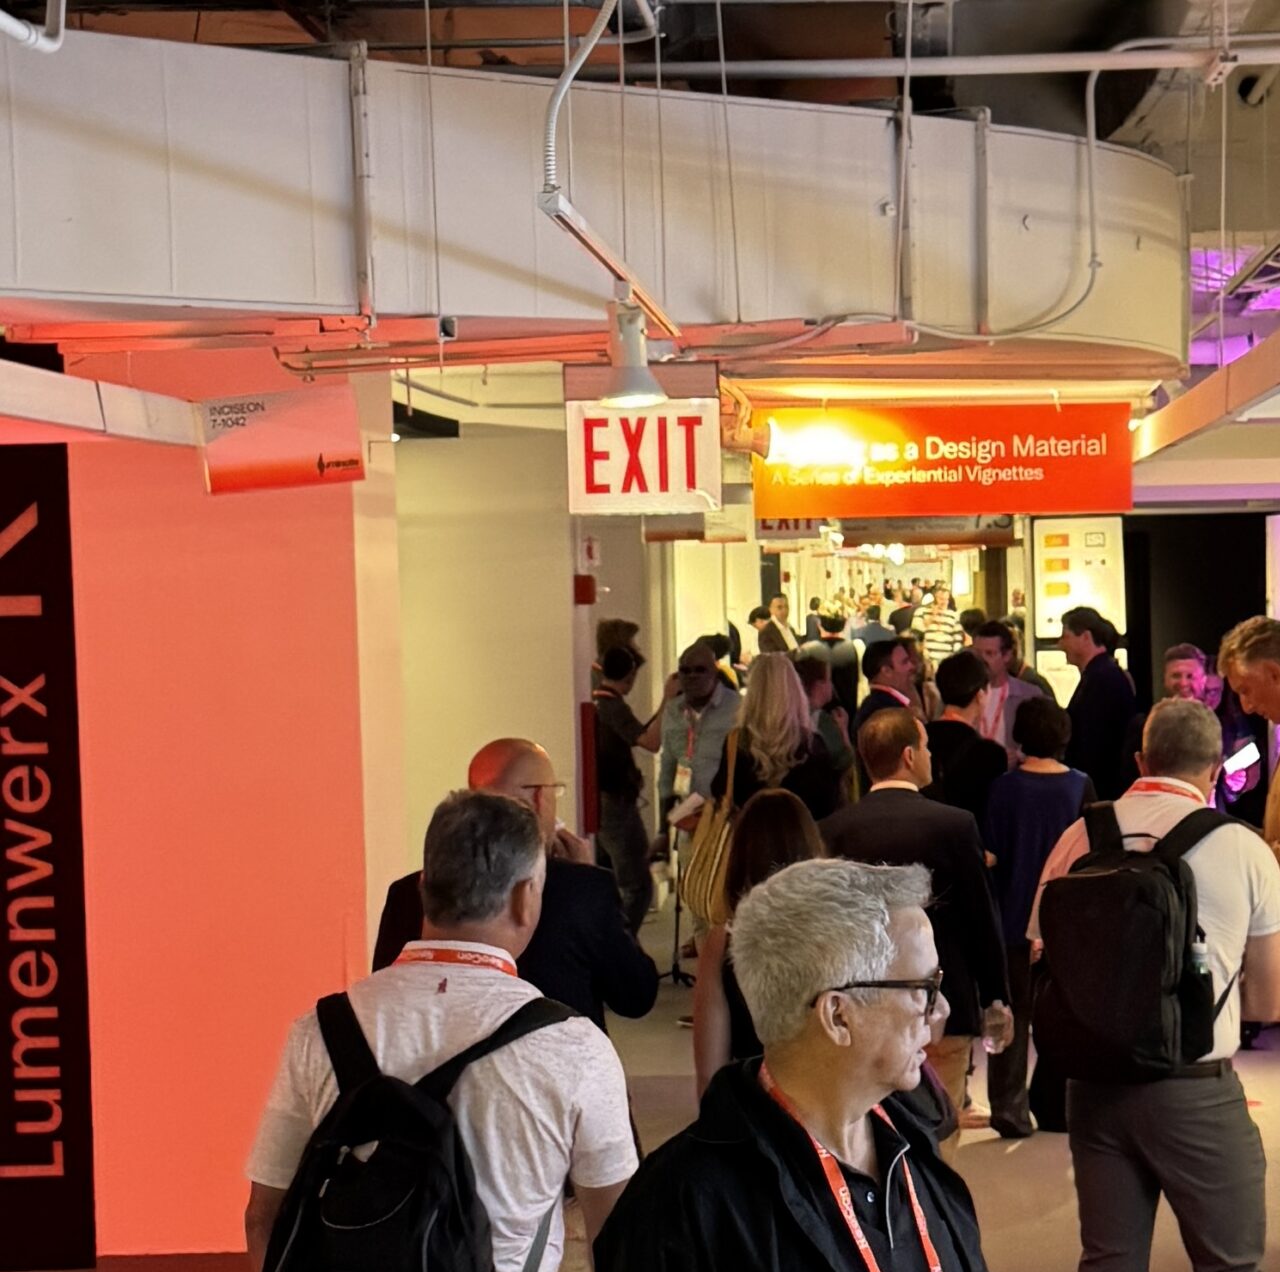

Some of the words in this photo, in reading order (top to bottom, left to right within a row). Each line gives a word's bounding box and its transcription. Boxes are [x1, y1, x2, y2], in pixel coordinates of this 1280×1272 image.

[583, 415, 703, 494] EXIT
[904, 441, 919, 460] a
[926, 435, 1005, 464] Design
[1012, 432, 1107, 458] Material
[772, 469, 785, 485] A
[863, 465, 962, 488] Experiential
[965, 465, 1044, 486] Vignettes
[0, 673, 66, 1178] Lumenwerx
